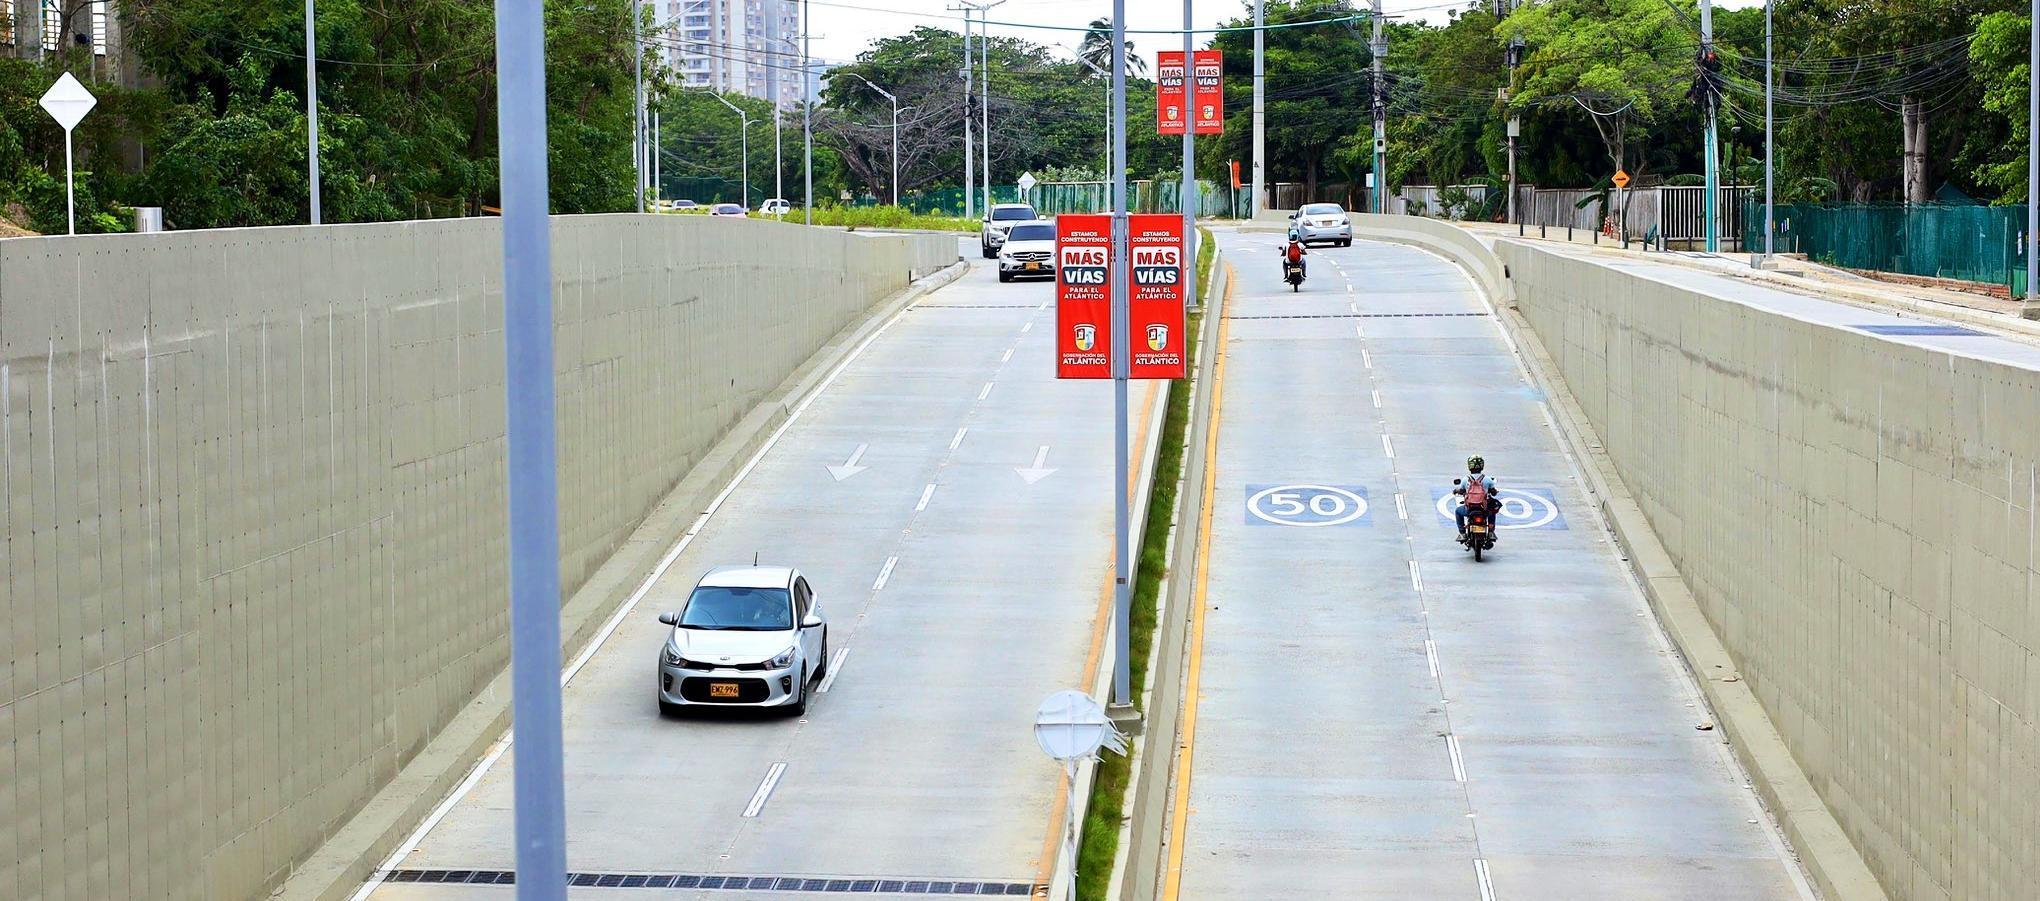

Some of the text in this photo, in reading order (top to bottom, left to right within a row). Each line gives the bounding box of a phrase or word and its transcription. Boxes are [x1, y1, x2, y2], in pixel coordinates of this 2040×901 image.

[1161, 77, 1182, 86] VÍAS
[1198, 77, 1218, 86] VÍAS
[1065, 249, 1105, 265] MÁS
[1137, 249, 1177, 265] MÁS
[1064, 268, 1105, 284] VÍAS
[1136, 268, 1177, 284] VÍAS
[1063, 357, 1107, 365] ATLÁNTICO
[1135, 357, 1180, 365] ATLÁNTICO
[1271, 493, 1346, 516] 50
